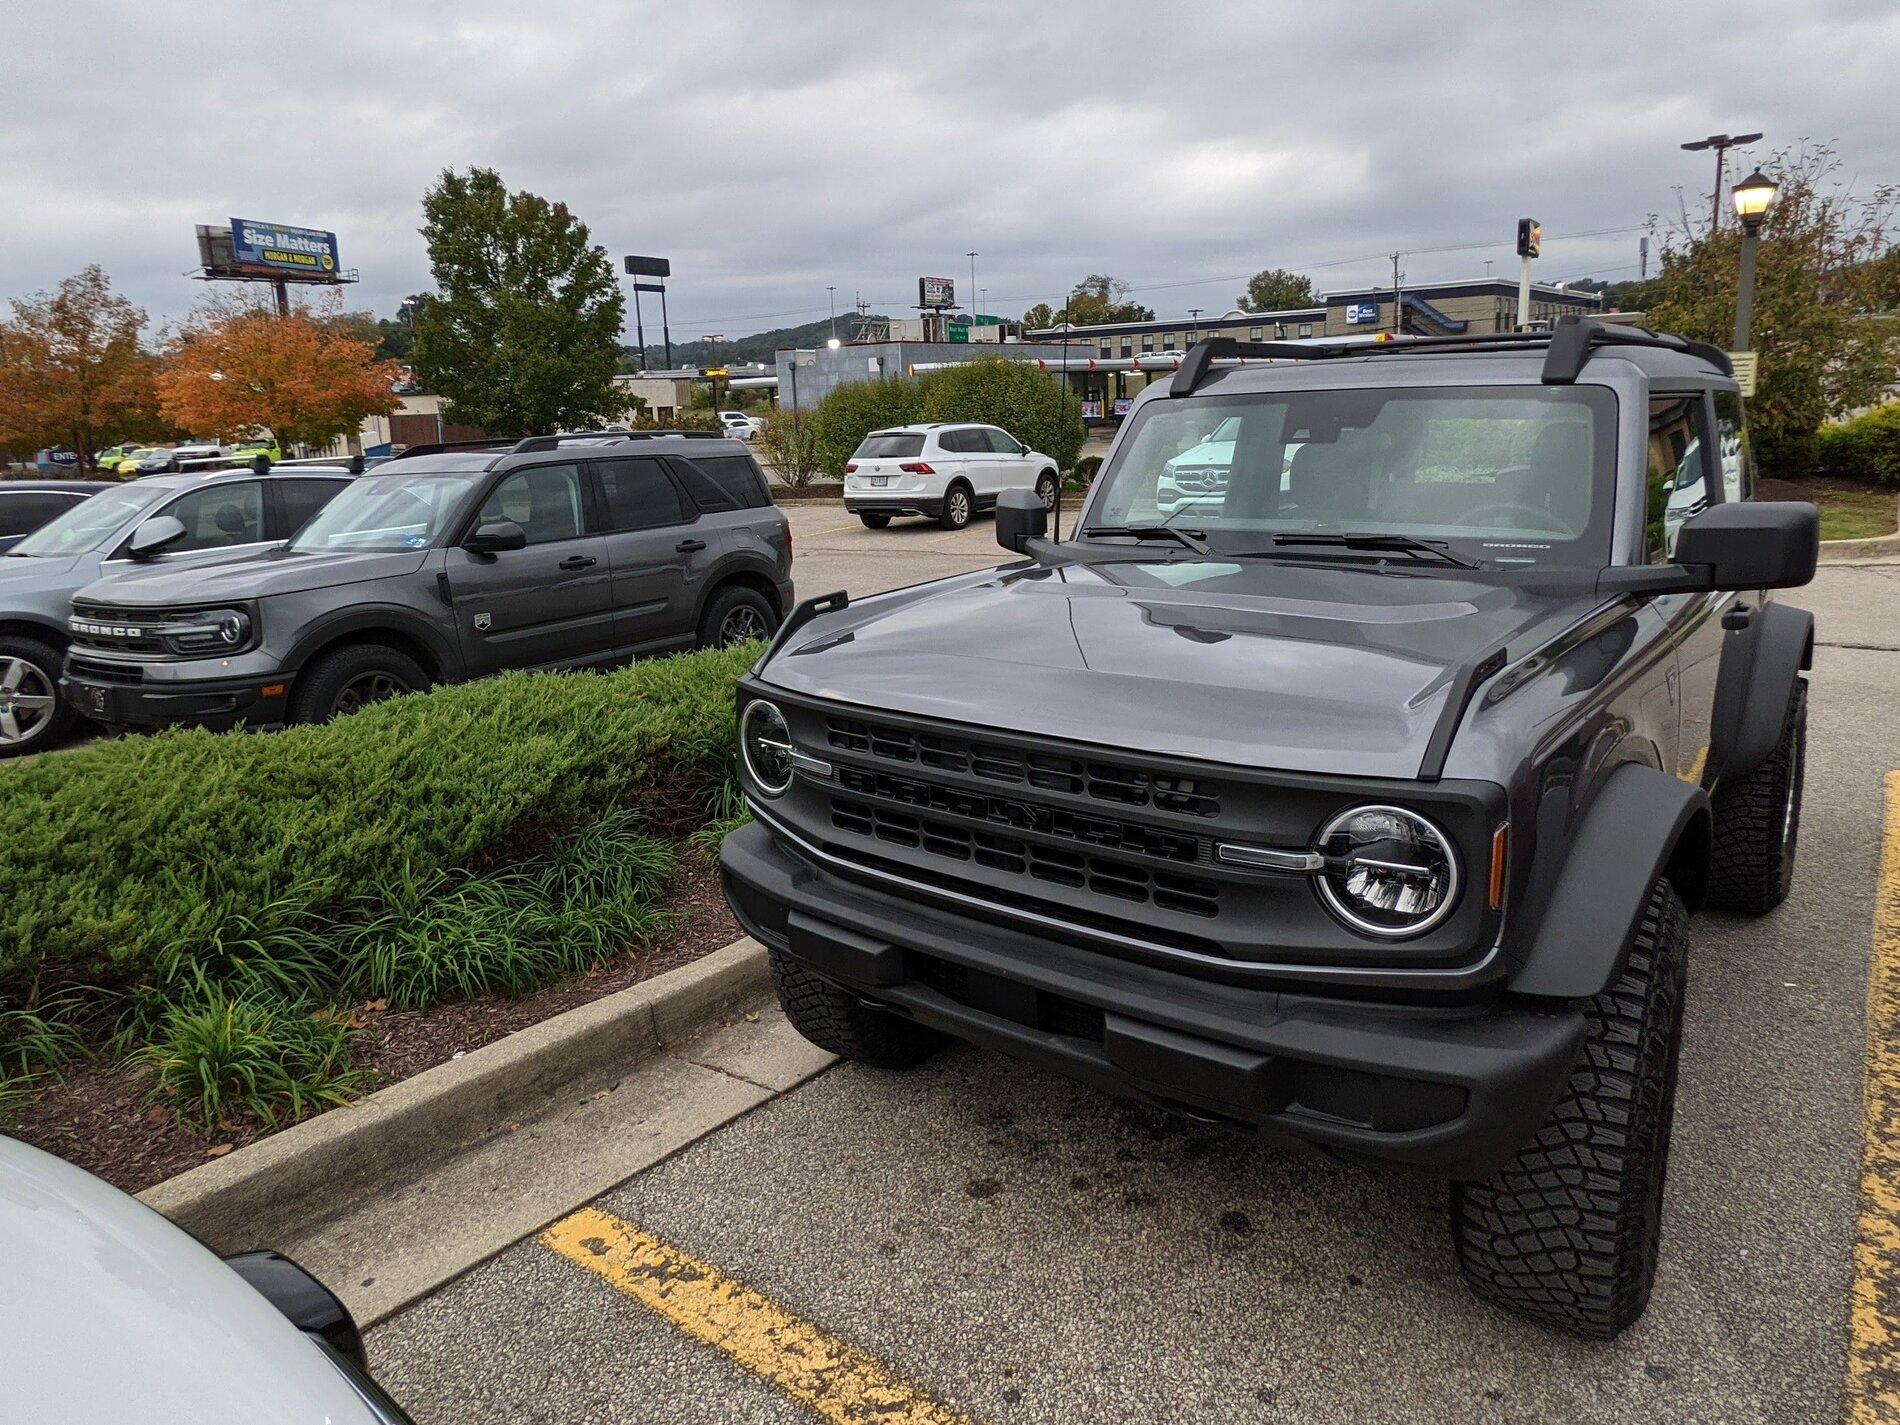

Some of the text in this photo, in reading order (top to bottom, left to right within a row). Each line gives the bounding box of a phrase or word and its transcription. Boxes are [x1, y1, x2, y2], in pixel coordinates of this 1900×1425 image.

[242, 228, 274, 247] Size
[276, 233, 330, 254] Matters
[265, 251, 288, 262] MORGAN
[293, 255, 316, 265] MORGAN
[54, 452, 77, 460] ENTE
[72, 622, 141, 637] BRONCO
[838, 765, 1197, 862] BRONCO
